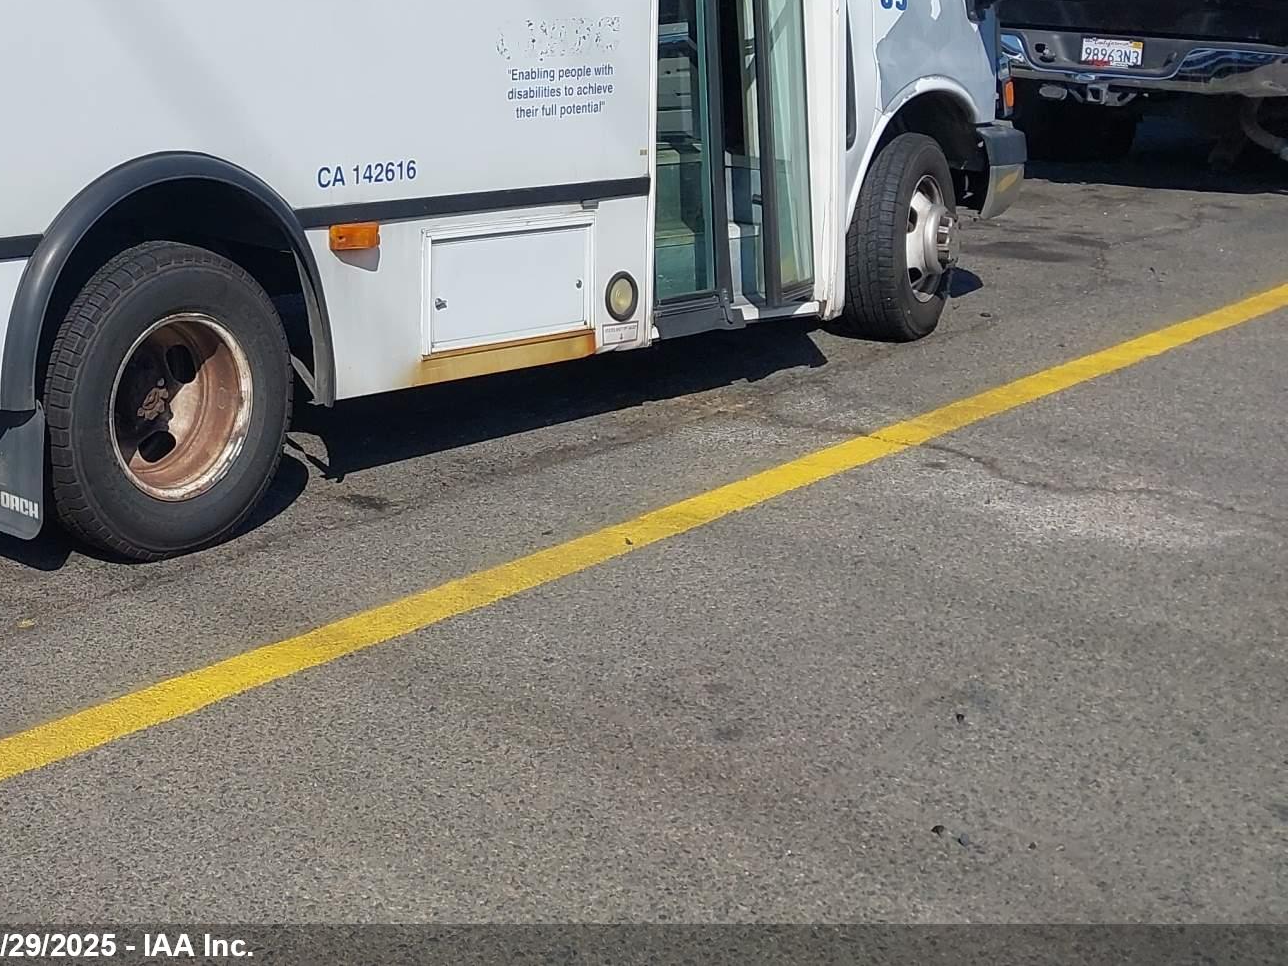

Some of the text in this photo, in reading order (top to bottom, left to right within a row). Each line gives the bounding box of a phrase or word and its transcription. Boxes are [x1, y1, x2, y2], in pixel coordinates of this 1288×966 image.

[1084, 46, 1140, 65] 98963N3
[508, 64, 614, 81] "Enabling people with
[507, 83, 614, 100] disabilities to achieve
[516, 101, 606, 118] their full potential"
[317, 160, 417, 188] CA 142616
